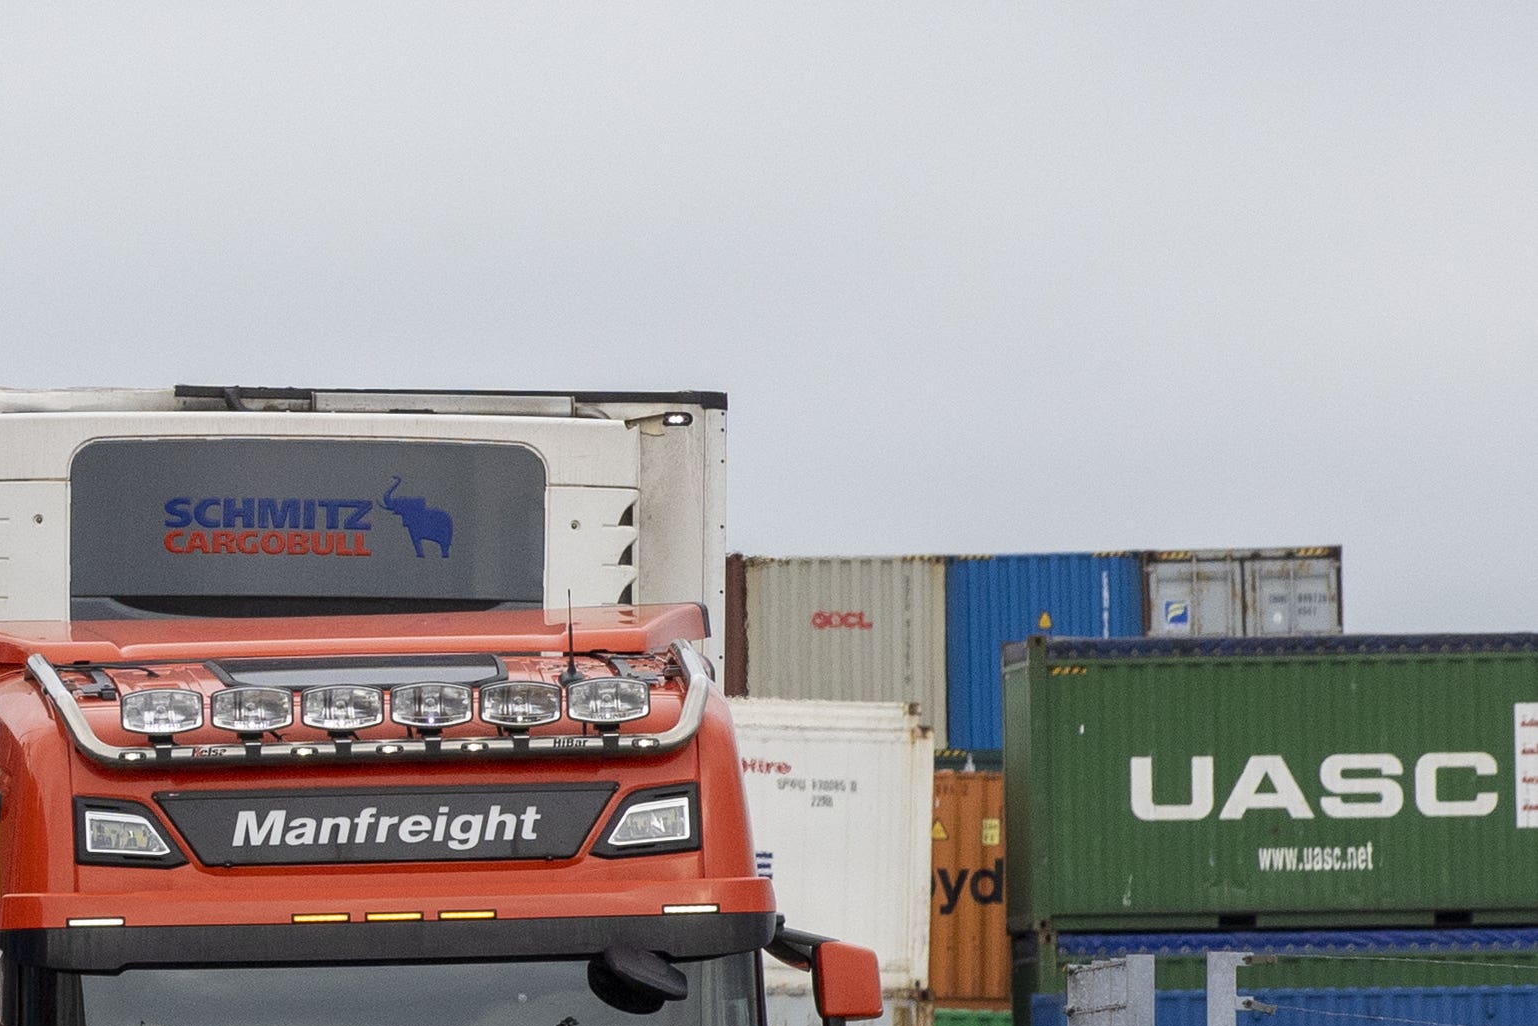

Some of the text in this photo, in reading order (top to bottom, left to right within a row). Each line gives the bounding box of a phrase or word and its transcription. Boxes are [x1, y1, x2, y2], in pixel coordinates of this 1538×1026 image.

[164, 497, 373, 530] SCHMITZ
[163, 530, 373, 557] CARGOBULL
[552, 738, 589, 749] HiBar
[1130, 751, 1499, 821] UASC
[232, 805, 542, 851] Manfreight
[1258, 841, 1374, 872] www.uasc.net
[932, 857, 1004, 915] yd
